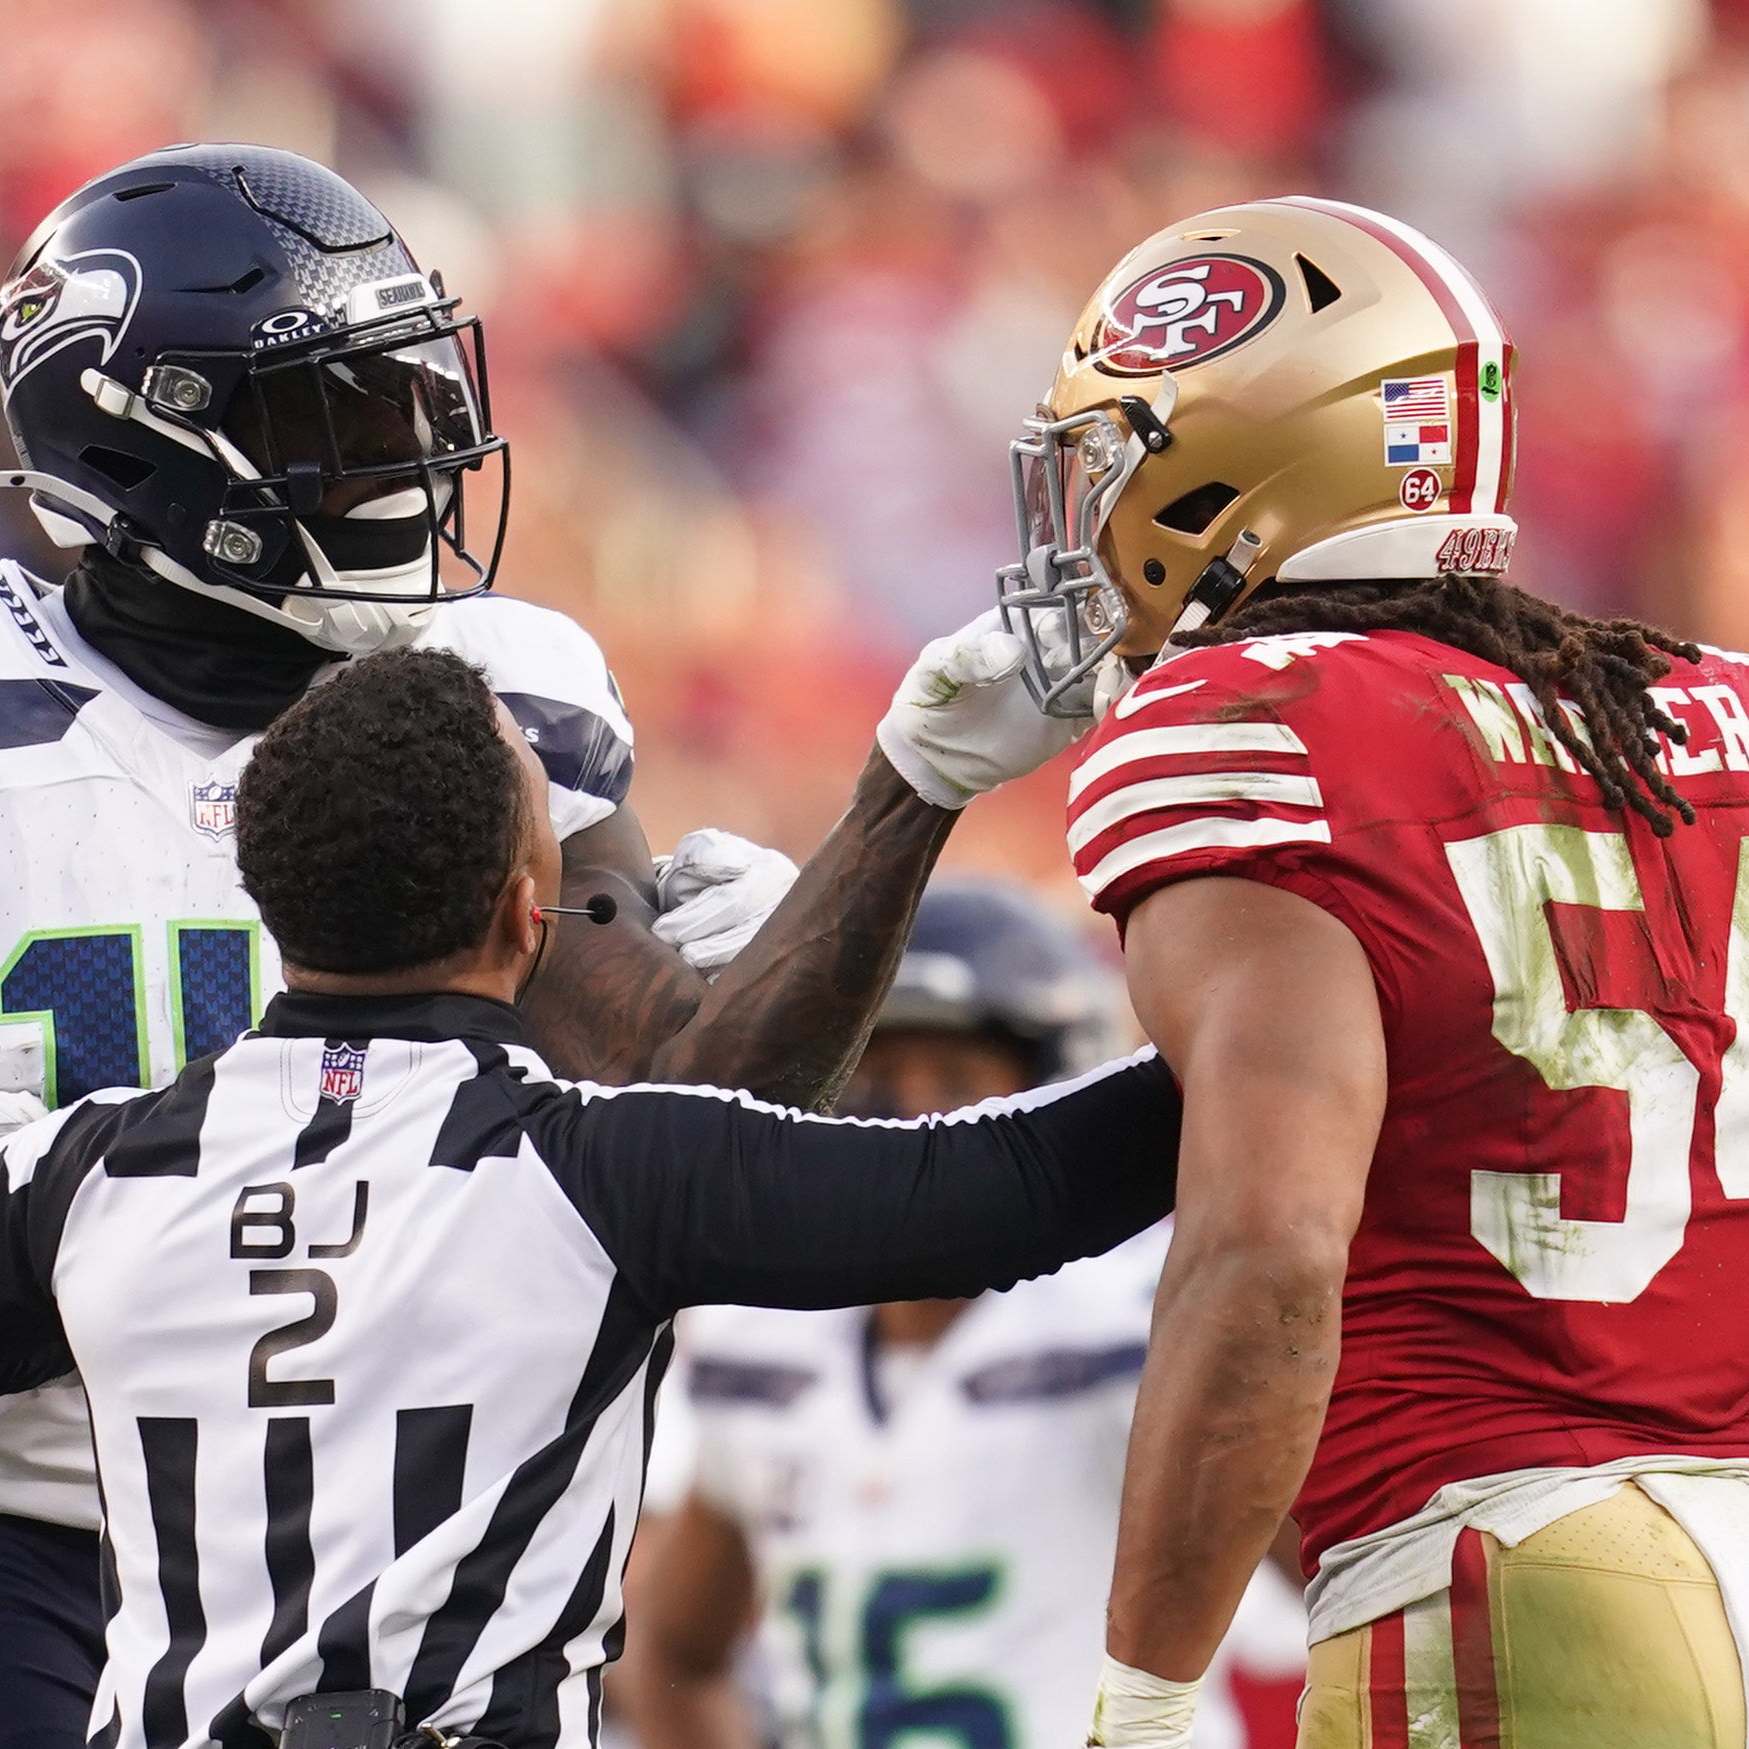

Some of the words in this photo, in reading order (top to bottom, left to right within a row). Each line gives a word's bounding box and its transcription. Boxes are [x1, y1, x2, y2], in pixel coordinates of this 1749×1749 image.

[377, 281, 426, 308] SEAHAWKS
[254, 323, 323, 349] OAKLEY
[1404, 476, 1435, 504] 64
[199, 804, 235, 828] NFL
[322, 1070, 358, 1096] NFL
[230, 1181, 369, 1258] BJ
[248, 1269, 339, 1408] 2
